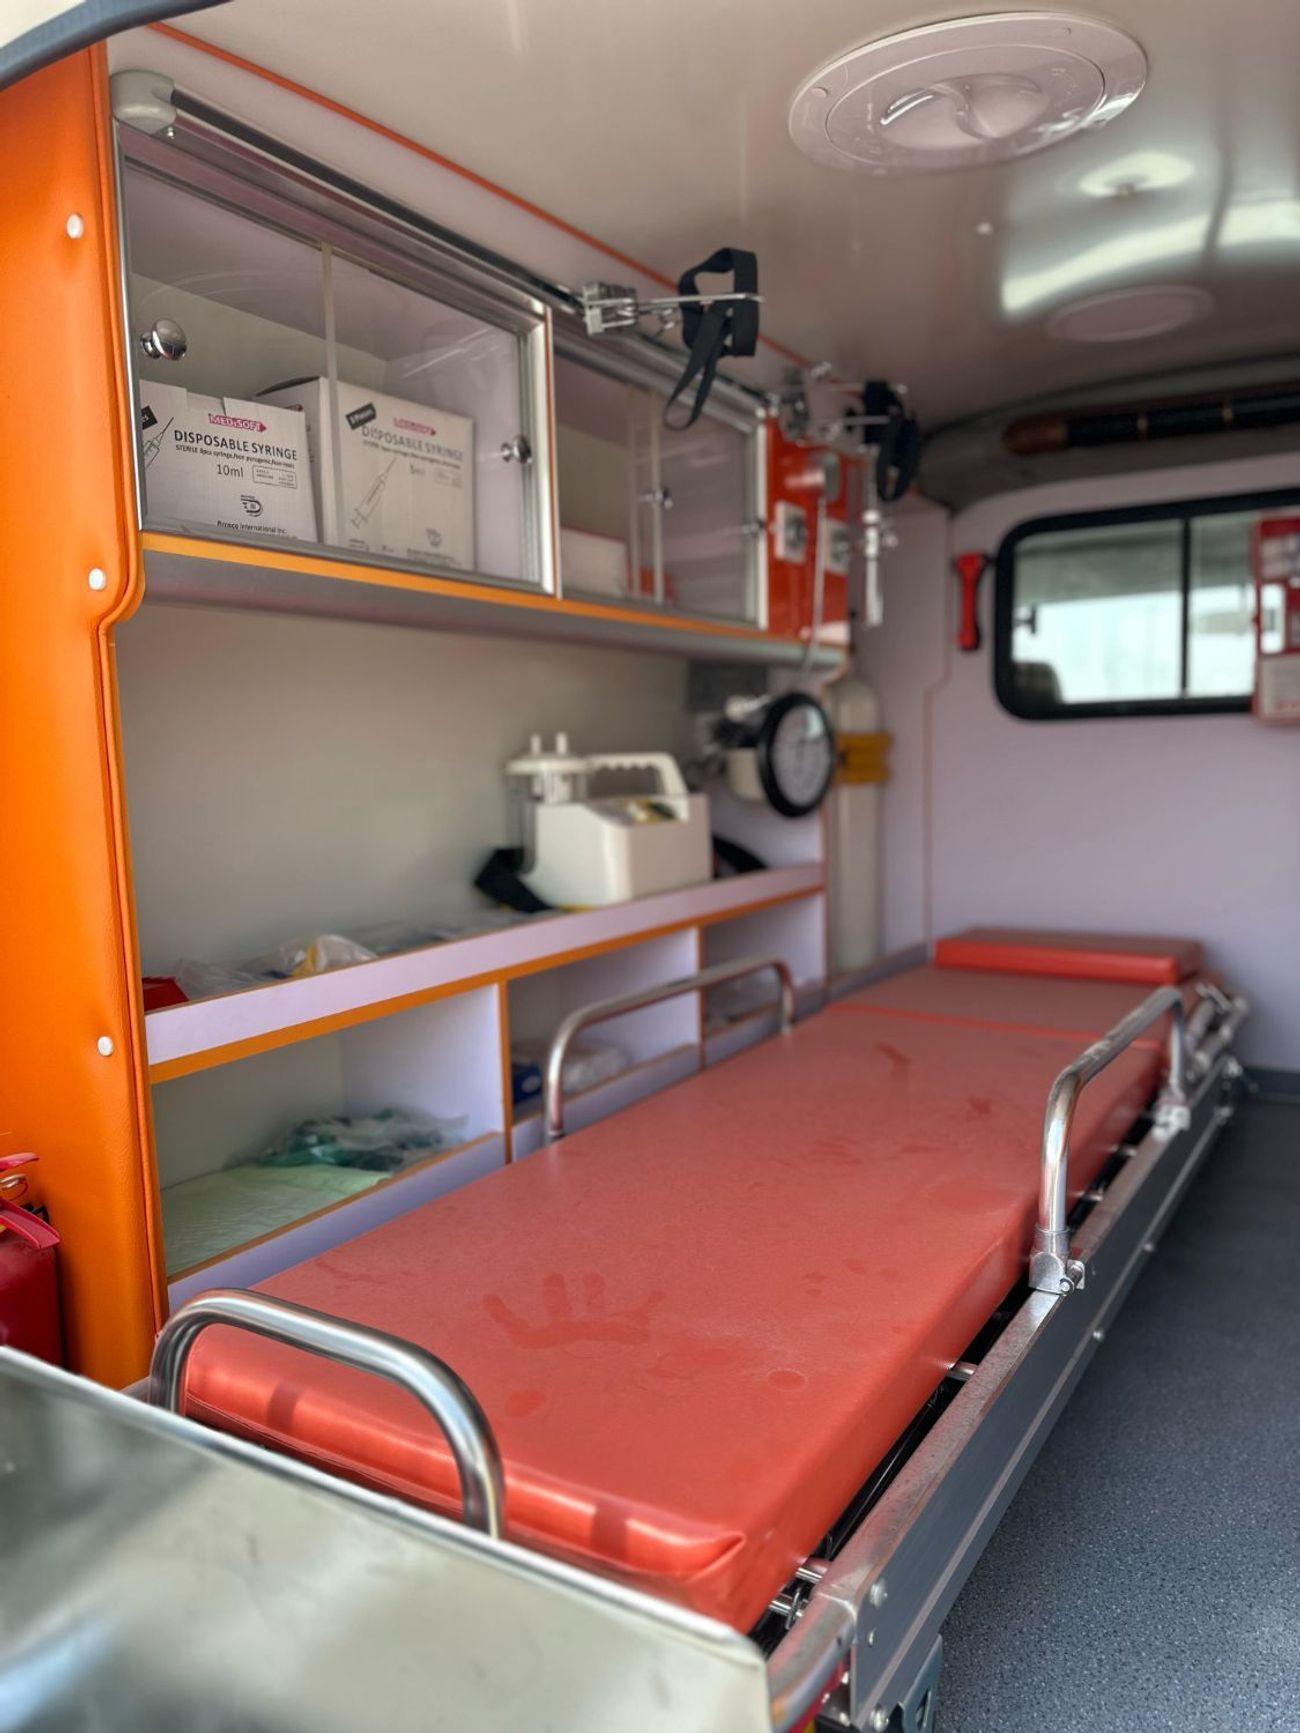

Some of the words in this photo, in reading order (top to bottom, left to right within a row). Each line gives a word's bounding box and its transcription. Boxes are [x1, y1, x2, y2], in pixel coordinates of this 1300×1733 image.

[174, 430, 249, 452] DISPOSABLE
[251, 442, 297, 461] SYRINGE
[217, 464, 244, 478] 10ml
